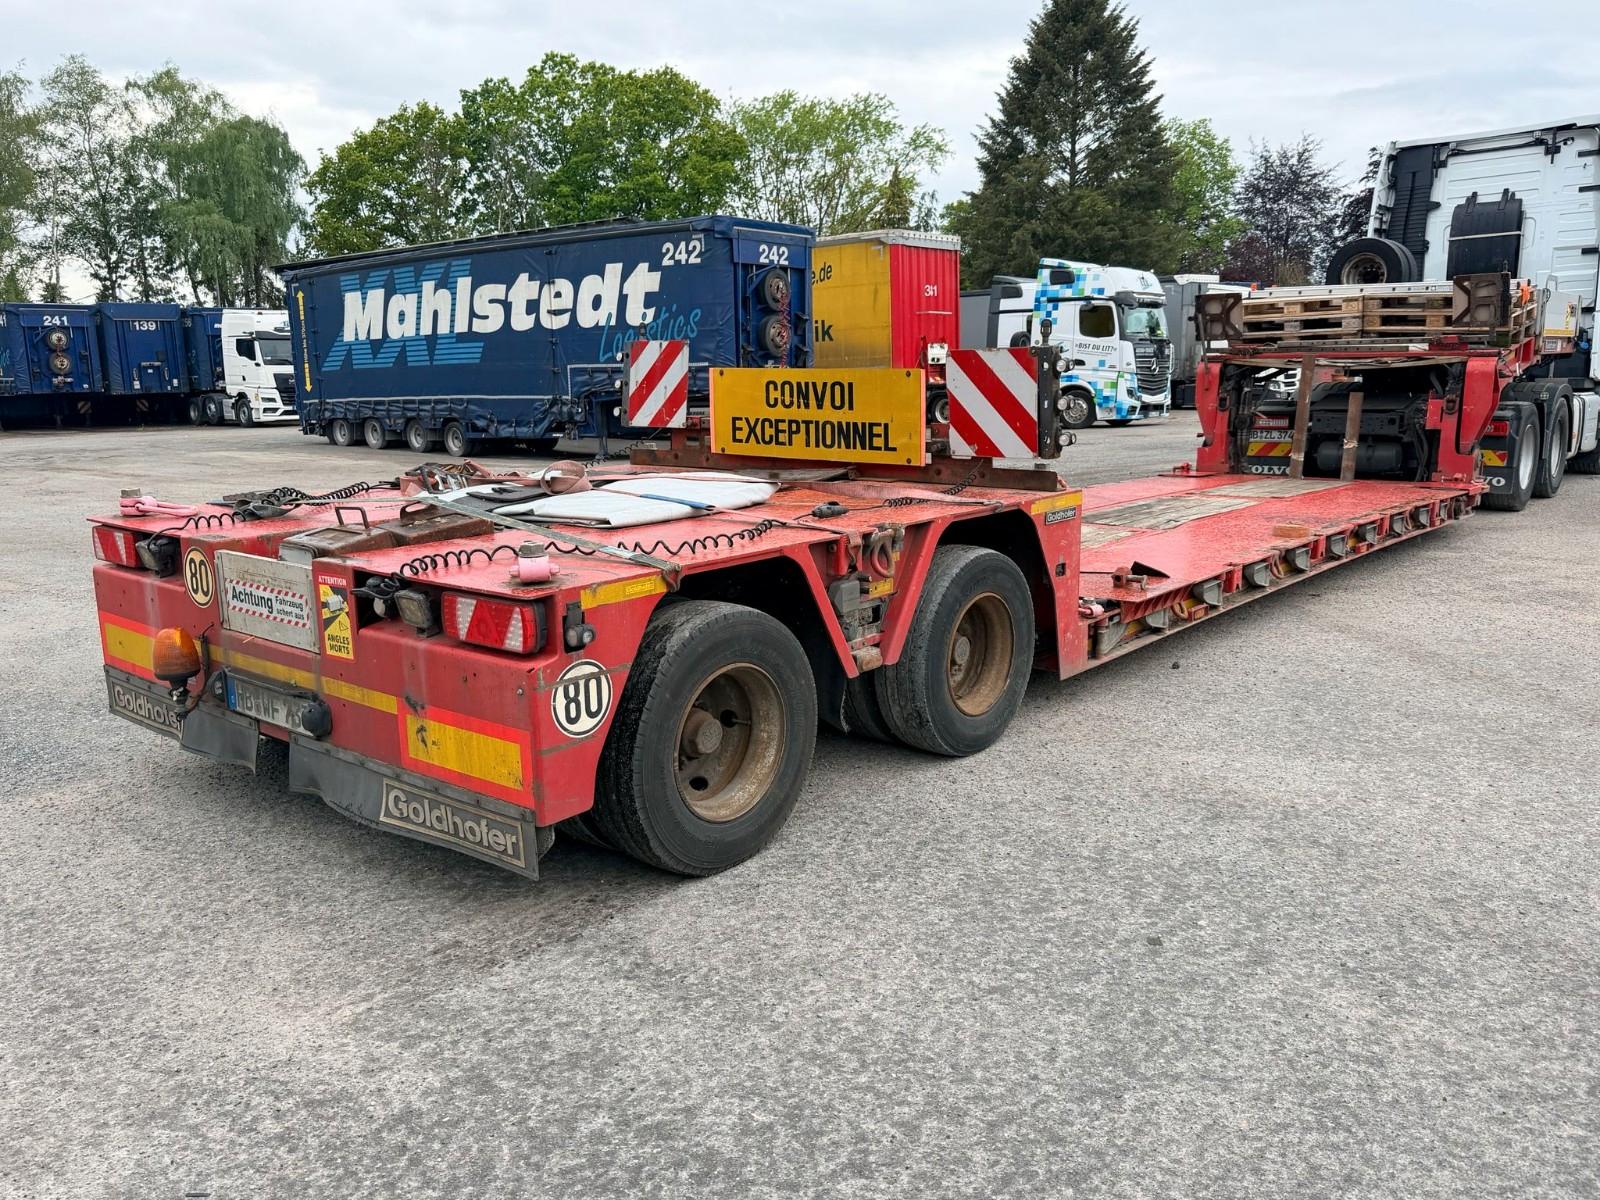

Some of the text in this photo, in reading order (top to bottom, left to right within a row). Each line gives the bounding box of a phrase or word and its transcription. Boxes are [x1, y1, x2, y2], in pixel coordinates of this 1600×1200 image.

[661, 239, 701, 266] 242
[759, 244, 789, 265] 242
[343, 262, 662, 342] Mahlstedt
[43, 315, 69, 326] 241
[133, 321, 157, 331] 139
[599, 303, 702, 362] Lostics
[764, 380, 855, 411] CONVOI
[731, 416, 898, 452] EXCEPTIONNEL
[188, 555, 211, 597] 80
[318, 575, 347, 586] ATTENTION
[231, 585, 304, 614] Achtung Fahrzeug
[327, 633, 350, 646] ANGLES
[329, 643, 350, 655] MORTS
[562, 674, 603, 726] 80
[387, 789, 518, 856] Goldhofer
